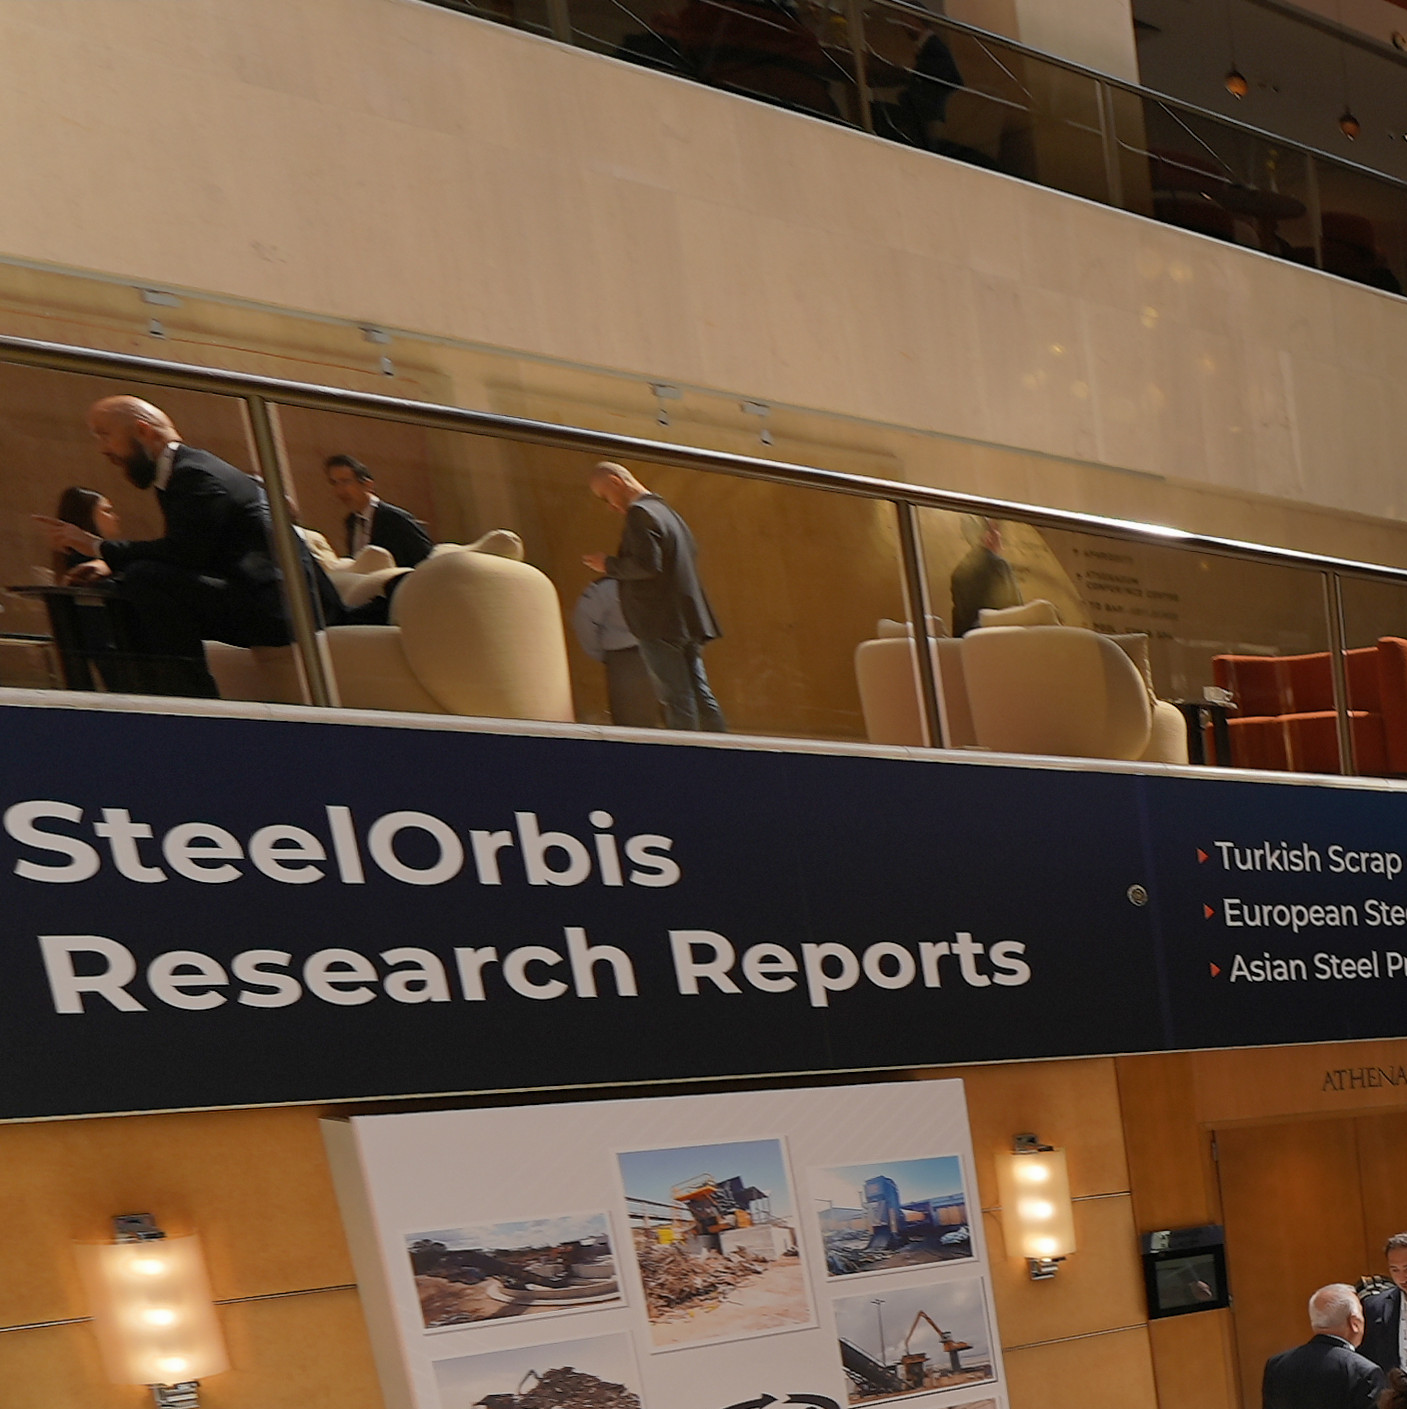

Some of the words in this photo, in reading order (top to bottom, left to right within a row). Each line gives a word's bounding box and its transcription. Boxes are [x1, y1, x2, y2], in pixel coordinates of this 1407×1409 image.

[4, 800, 680, 887] SteelOrbis
[1214, 841, 1322, 872] Turkish
[1328, 845, 1402, 880] Scrap
[1222, 898, 1359, 933] European
[37, 927, 638, 1014] Research
[668, 930, 1031, 1007] Reports
[1230, 952, 1308, 983] Asian
[1313, 950, 1380, 980] Steel
